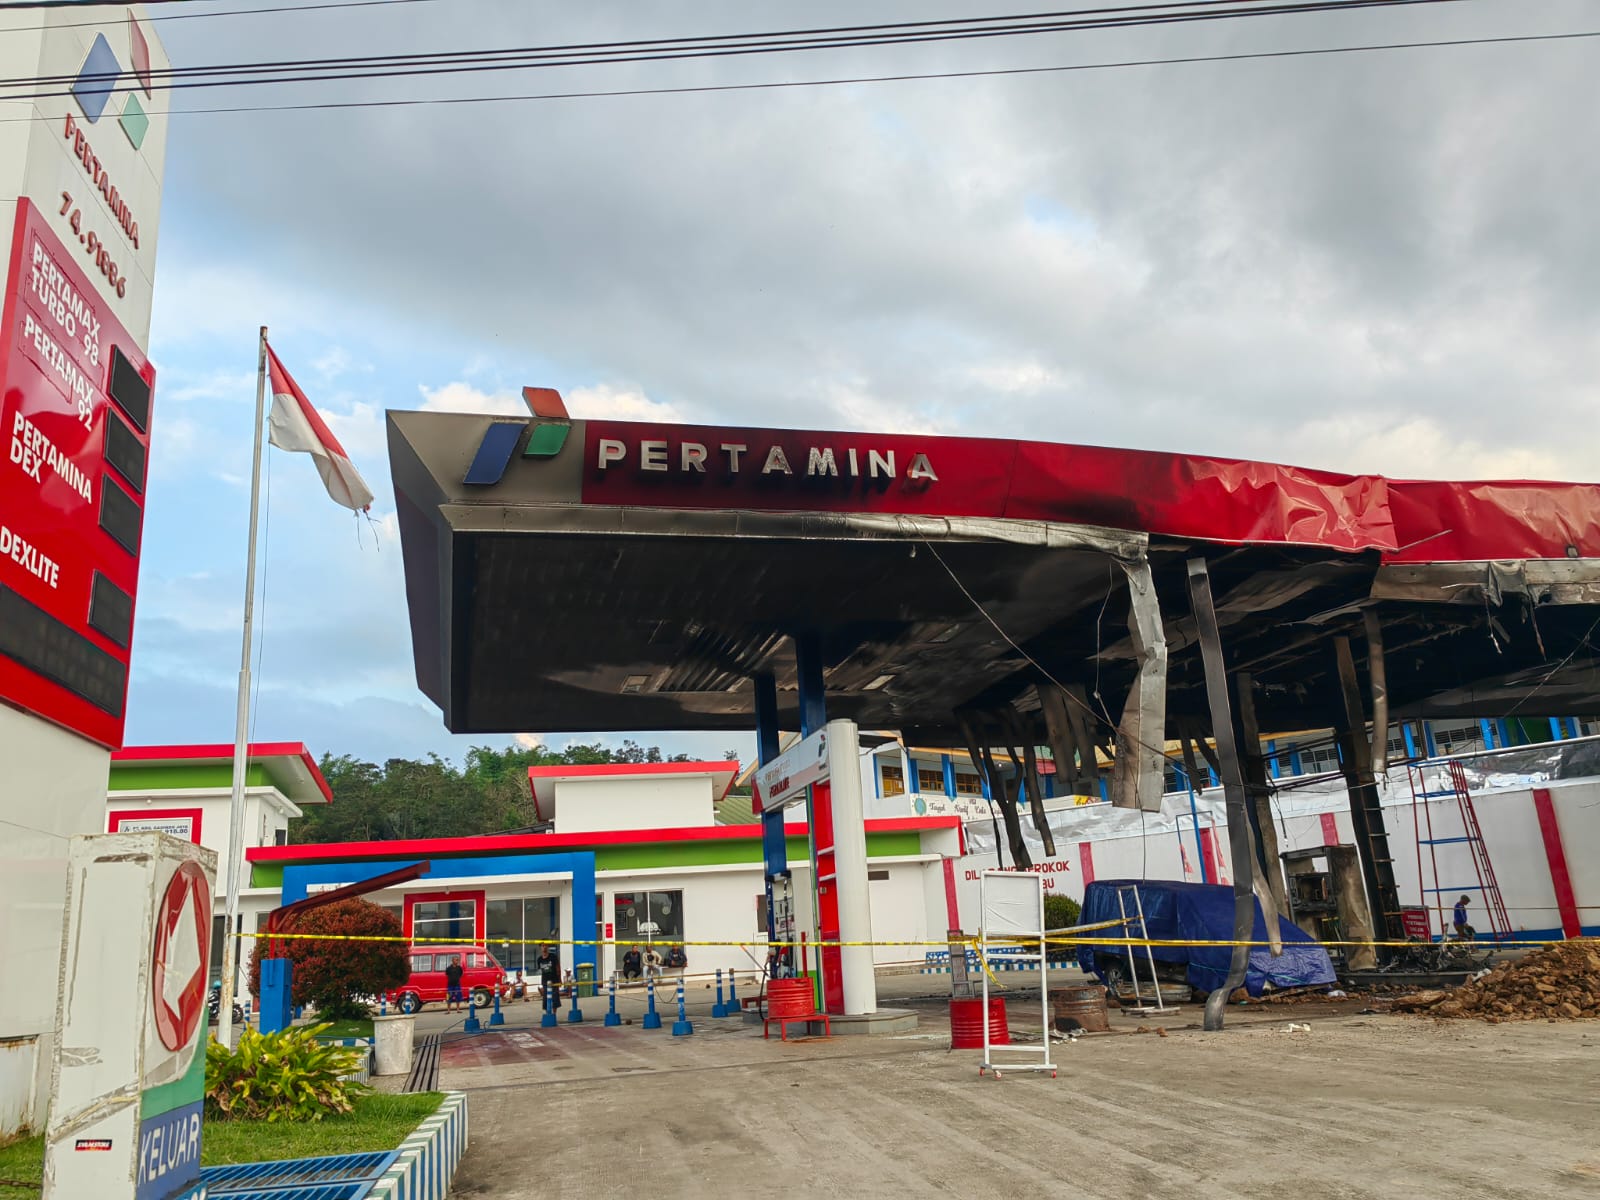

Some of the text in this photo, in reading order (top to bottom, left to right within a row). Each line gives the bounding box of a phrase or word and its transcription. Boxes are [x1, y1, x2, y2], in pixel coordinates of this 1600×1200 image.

[64, 113, 139, 250] PERTAMINA
[31, 266, 98, 367] TURBO 98
[32, 241, 101, 344] PERTAMAX
[24, 314, 93, 405] PERTAMAX
[13, 410, 92, 504] PERTAMINA
[78, 399, 93, 433] 92
[9, 435, 42, 484] DEX
[597, 439, 939, 481] PERTAMINA
[0, 525, 60, 589] DEXLITE
[138, 1113, 200, 1187] KELUAR
